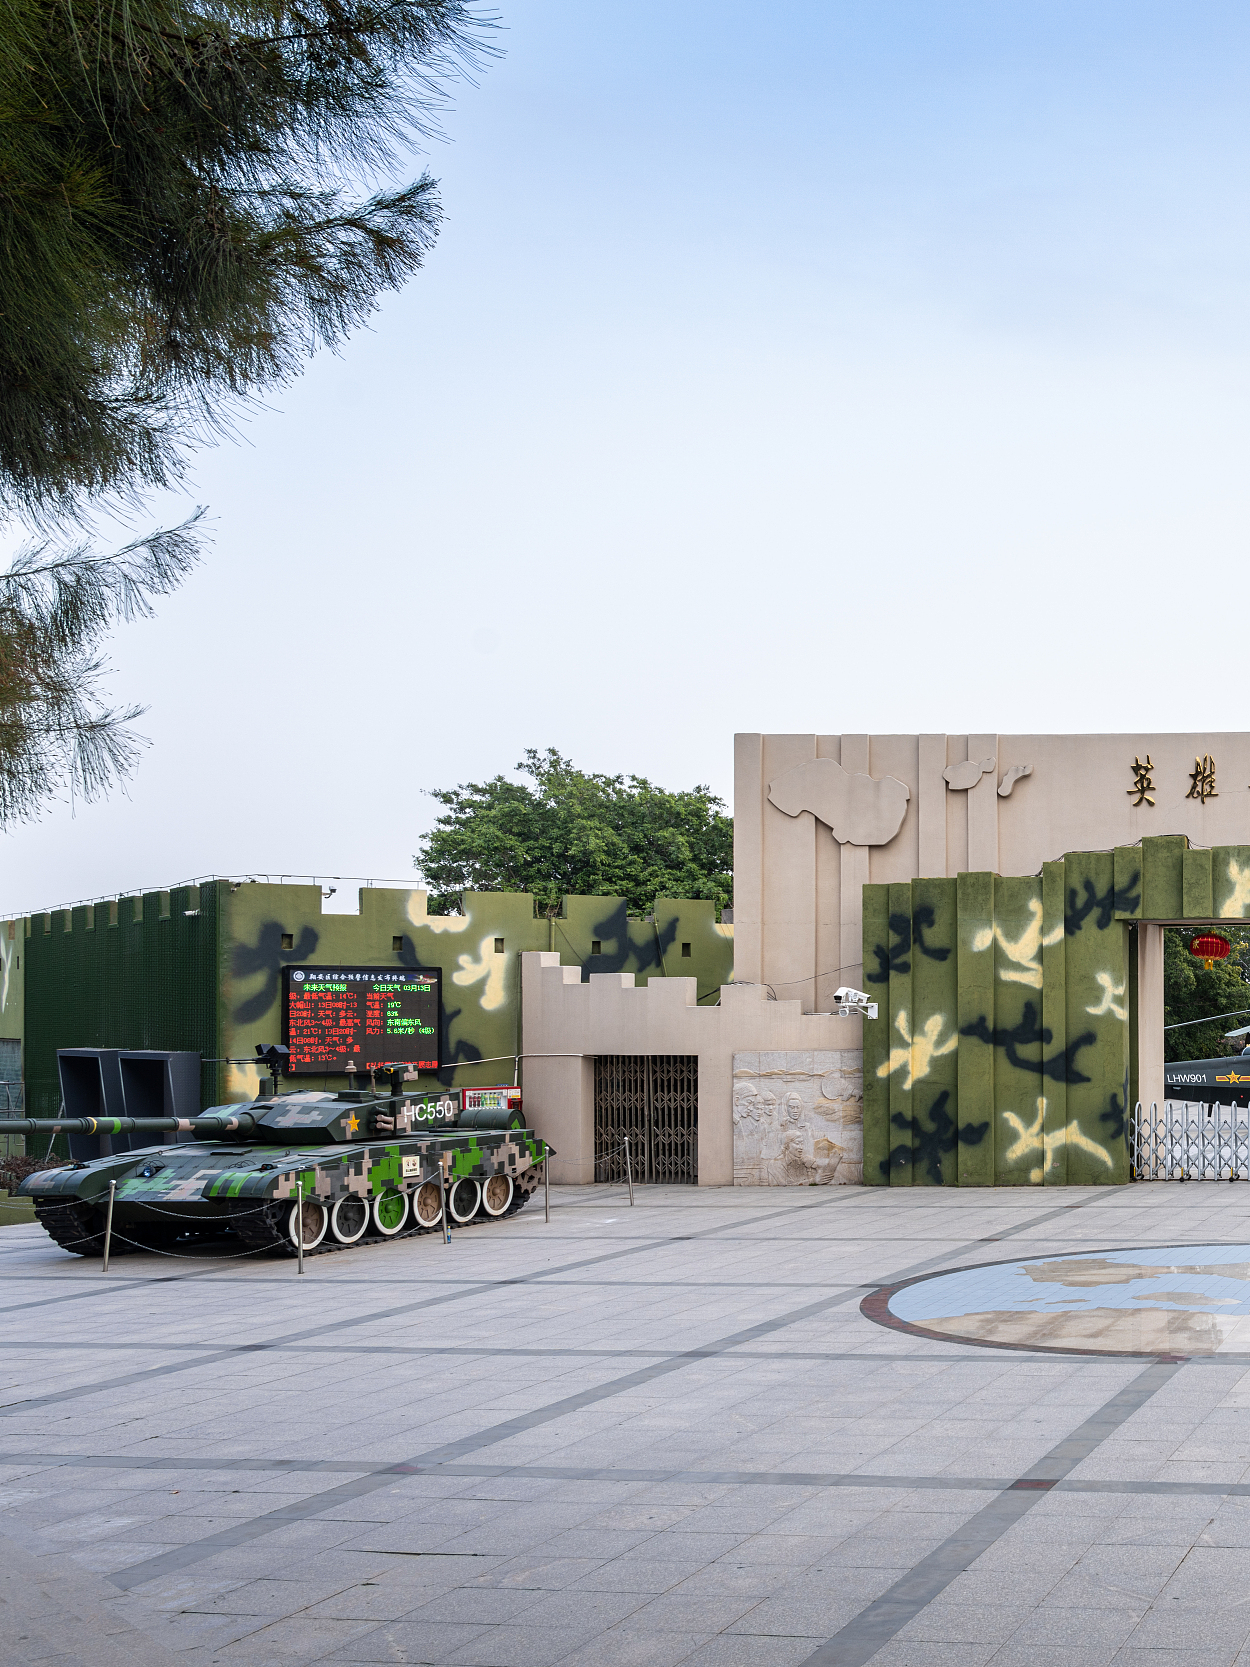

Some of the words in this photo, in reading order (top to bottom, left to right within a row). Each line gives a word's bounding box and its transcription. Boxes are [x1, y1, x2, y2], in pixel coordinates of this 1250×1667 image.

[303, 983, 348, 992] 未来天气预报
[372, 983, 401, 992] 今日天气
[403, 984, 431, 992] 03月13日
[366, 992, 395, 1000] 当前天气
[1166, 1073, 1207, 1083] LHW901
[403, 1100, 453, 1123] HC550
